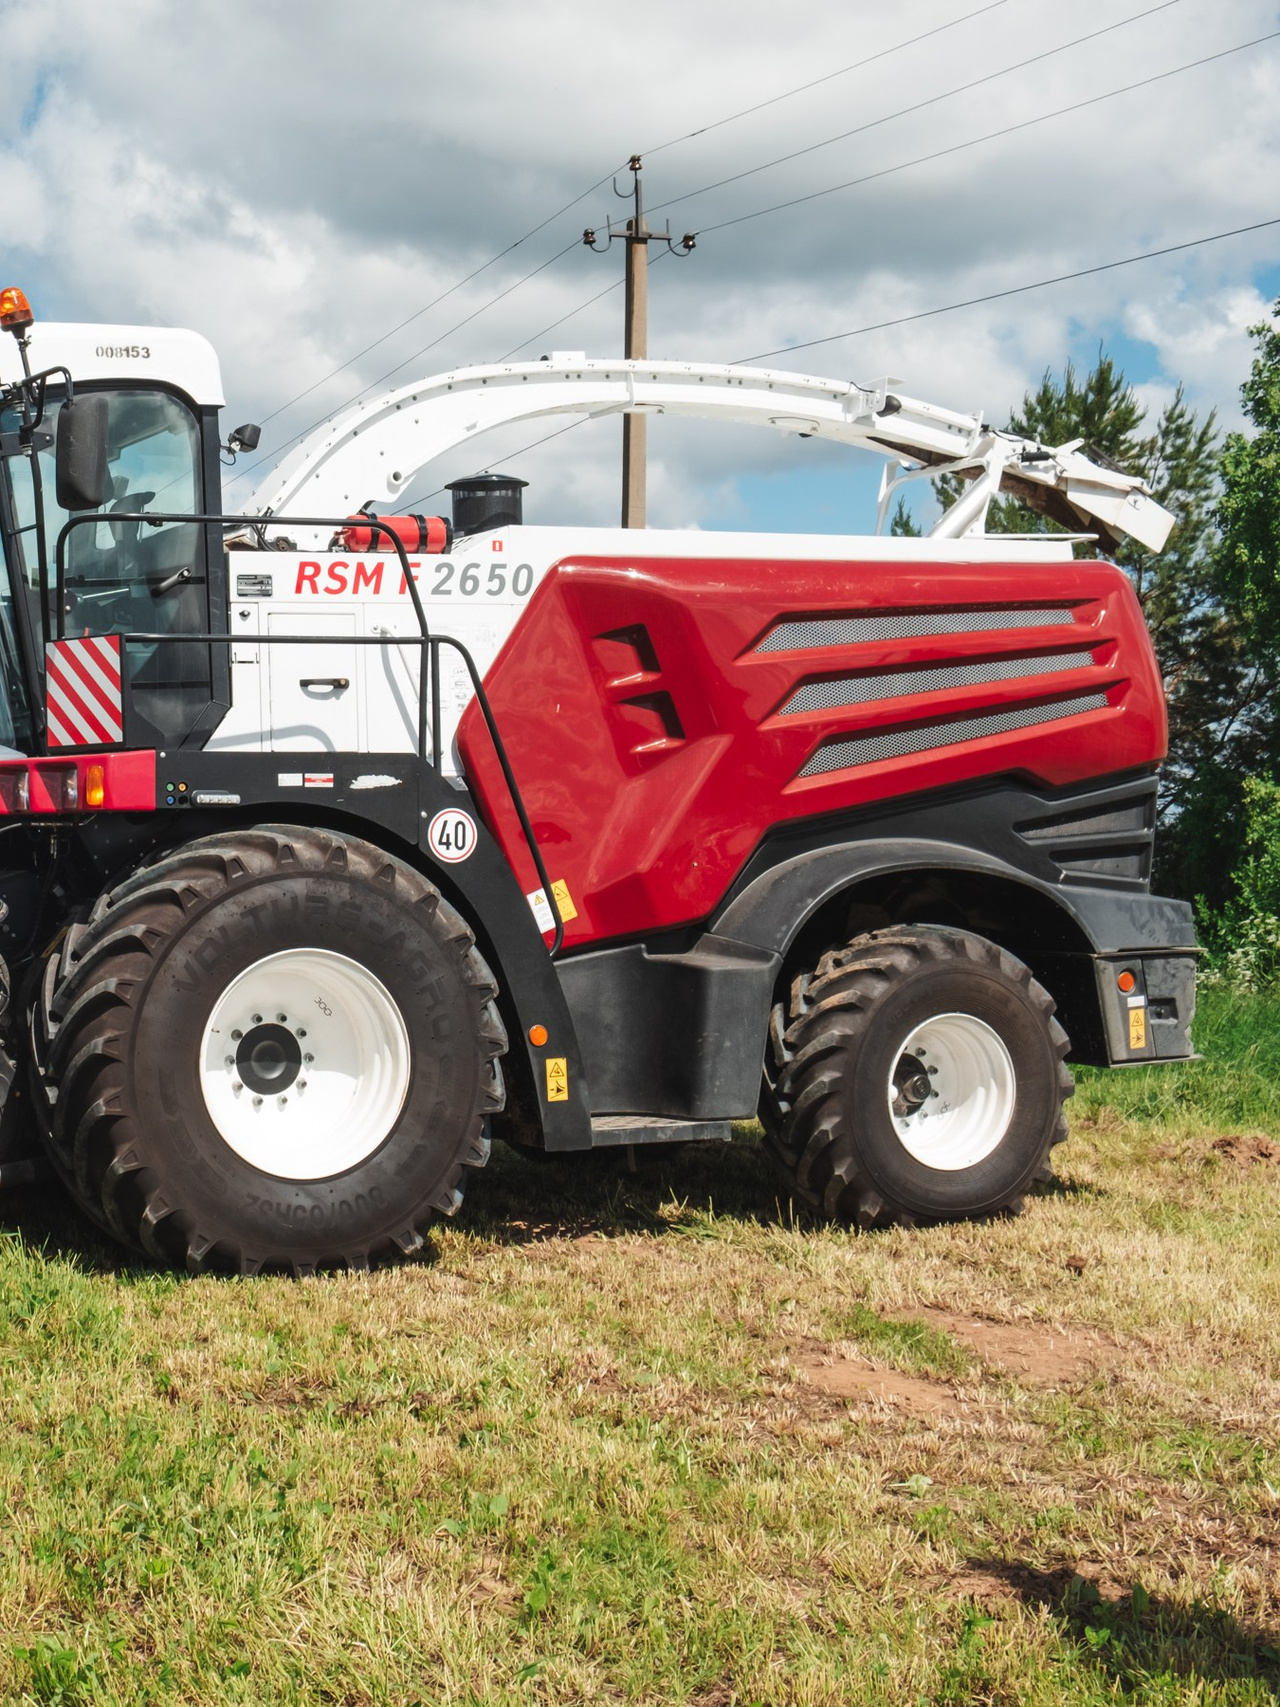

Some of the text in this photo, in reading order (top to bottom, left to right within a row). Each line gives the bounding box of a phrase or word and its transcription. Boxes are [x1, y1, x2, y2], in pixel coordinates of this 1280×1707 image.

[95, 346, 151, 359] 008153
[294, 561, 385, 595] RSM
[398, 562, 422, 595] F
[430, 562, 535, 597] 2650
[438, 820, 466, 850] 40
